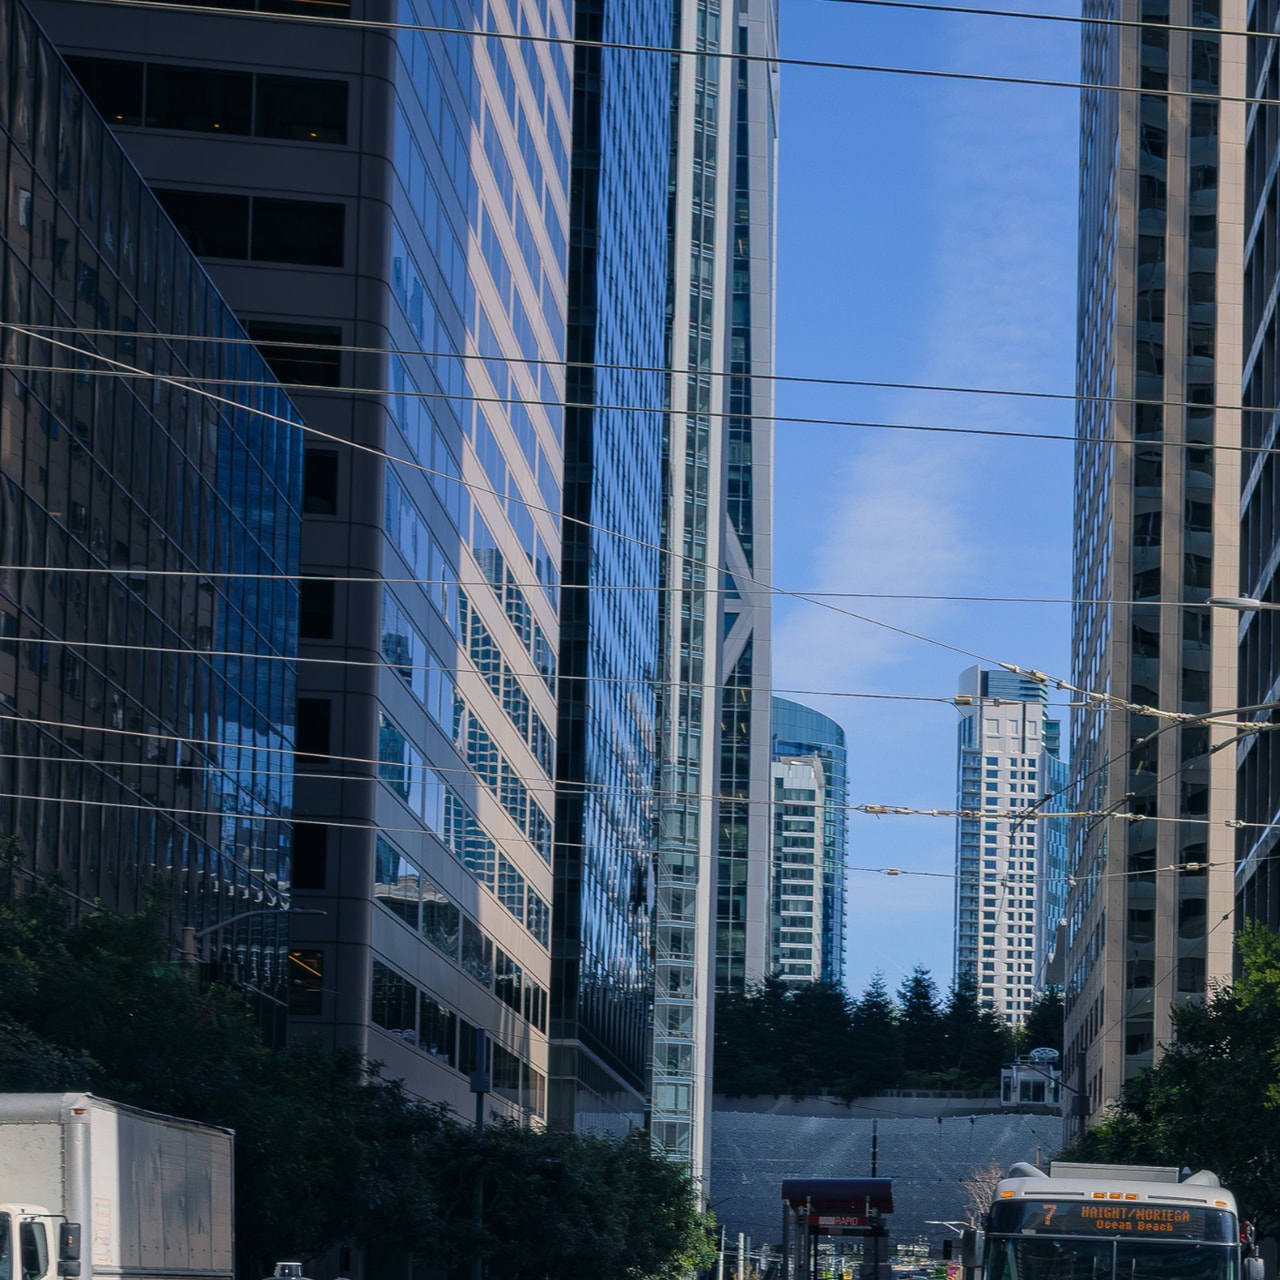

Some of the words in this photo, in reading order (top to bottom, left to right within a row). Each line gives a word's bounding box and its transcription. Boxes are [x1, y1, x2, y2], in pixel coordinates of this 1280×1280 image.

[835, 1216, 859, 1226] RAPID
[1042, 1204, 1057, 1226] 7
[1081, 1205, 1191, 1222] HAIGHT/NORIEGA
[1096, 1219, 1133, 1230] Ocean
[1137, 1219, 1174, 1232] Beach
